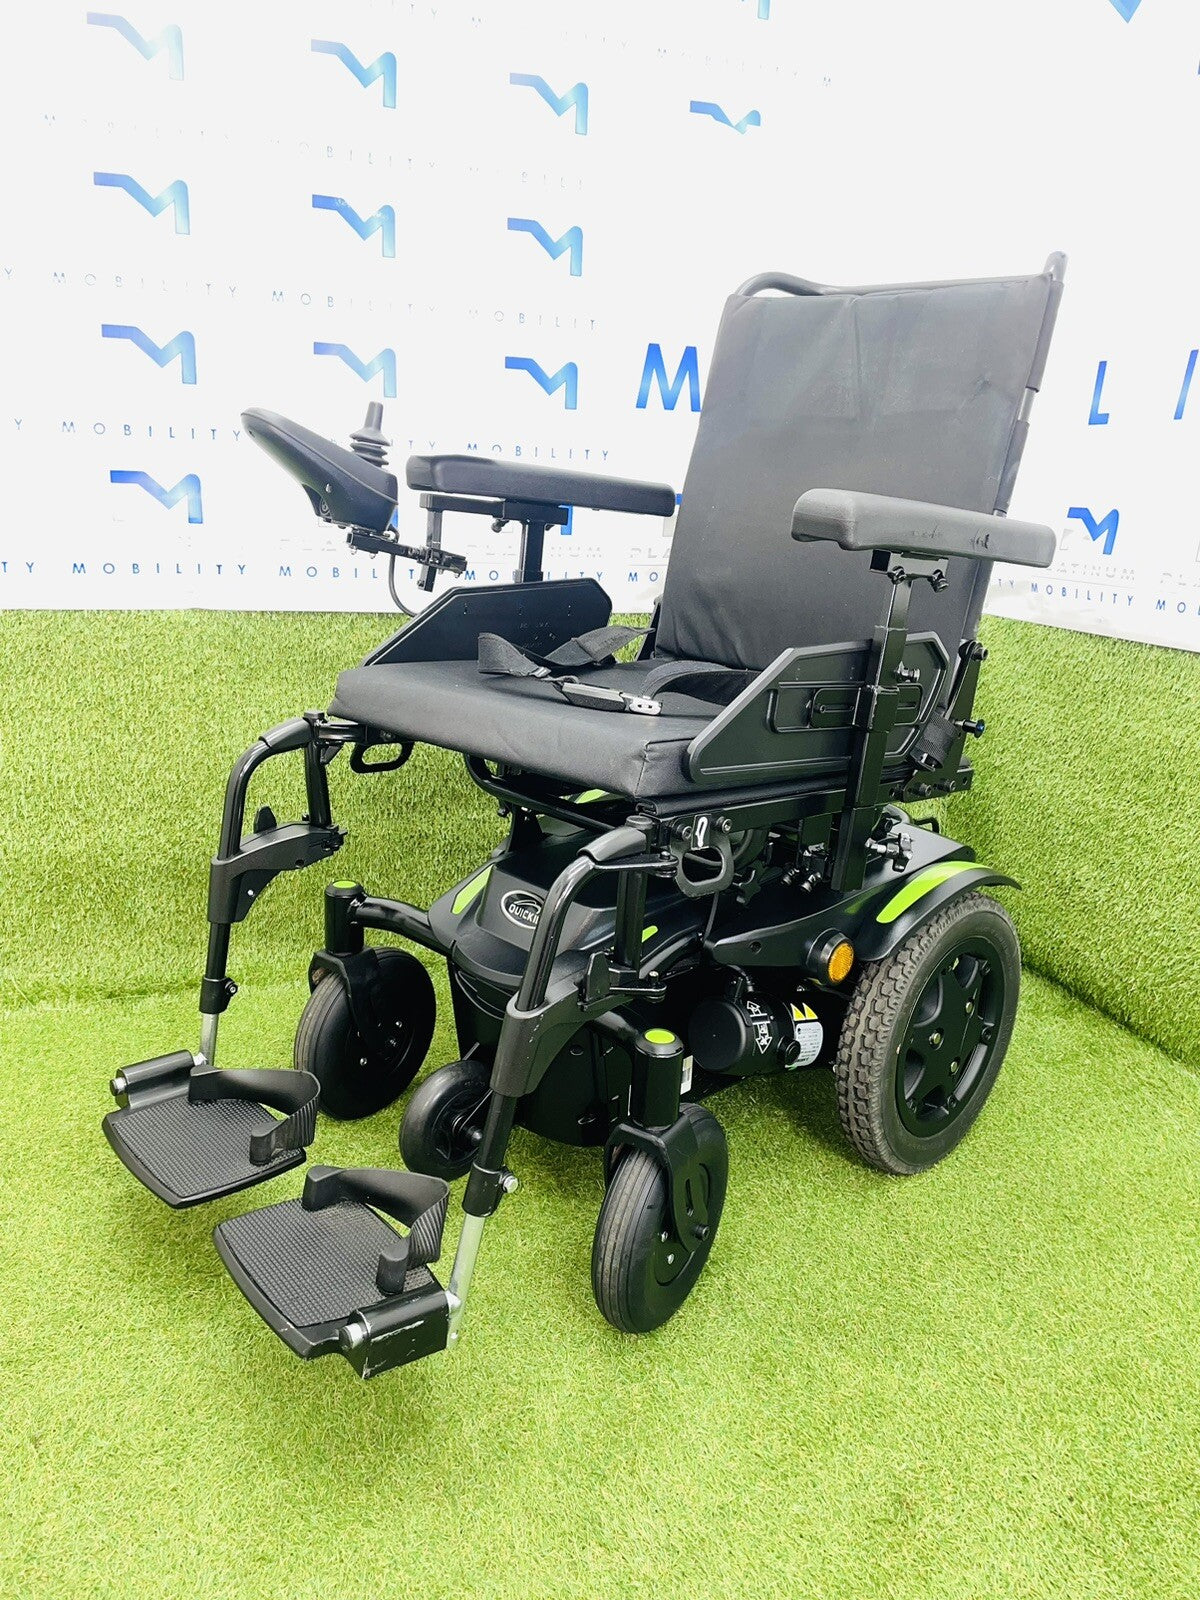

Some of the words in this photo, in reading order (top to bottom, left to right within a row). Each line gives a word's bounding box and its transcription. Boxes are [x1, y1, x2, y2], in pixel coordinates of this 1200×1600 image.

[61, 419, 242, 443] MOBILITY
[71, 561, 248, 576] MOBILITY
[278, 564, 416, 581] MOBILT
[1031, 582, 1135, 606] MOBILITY
[508, 903, 540, 925] QUICKI
